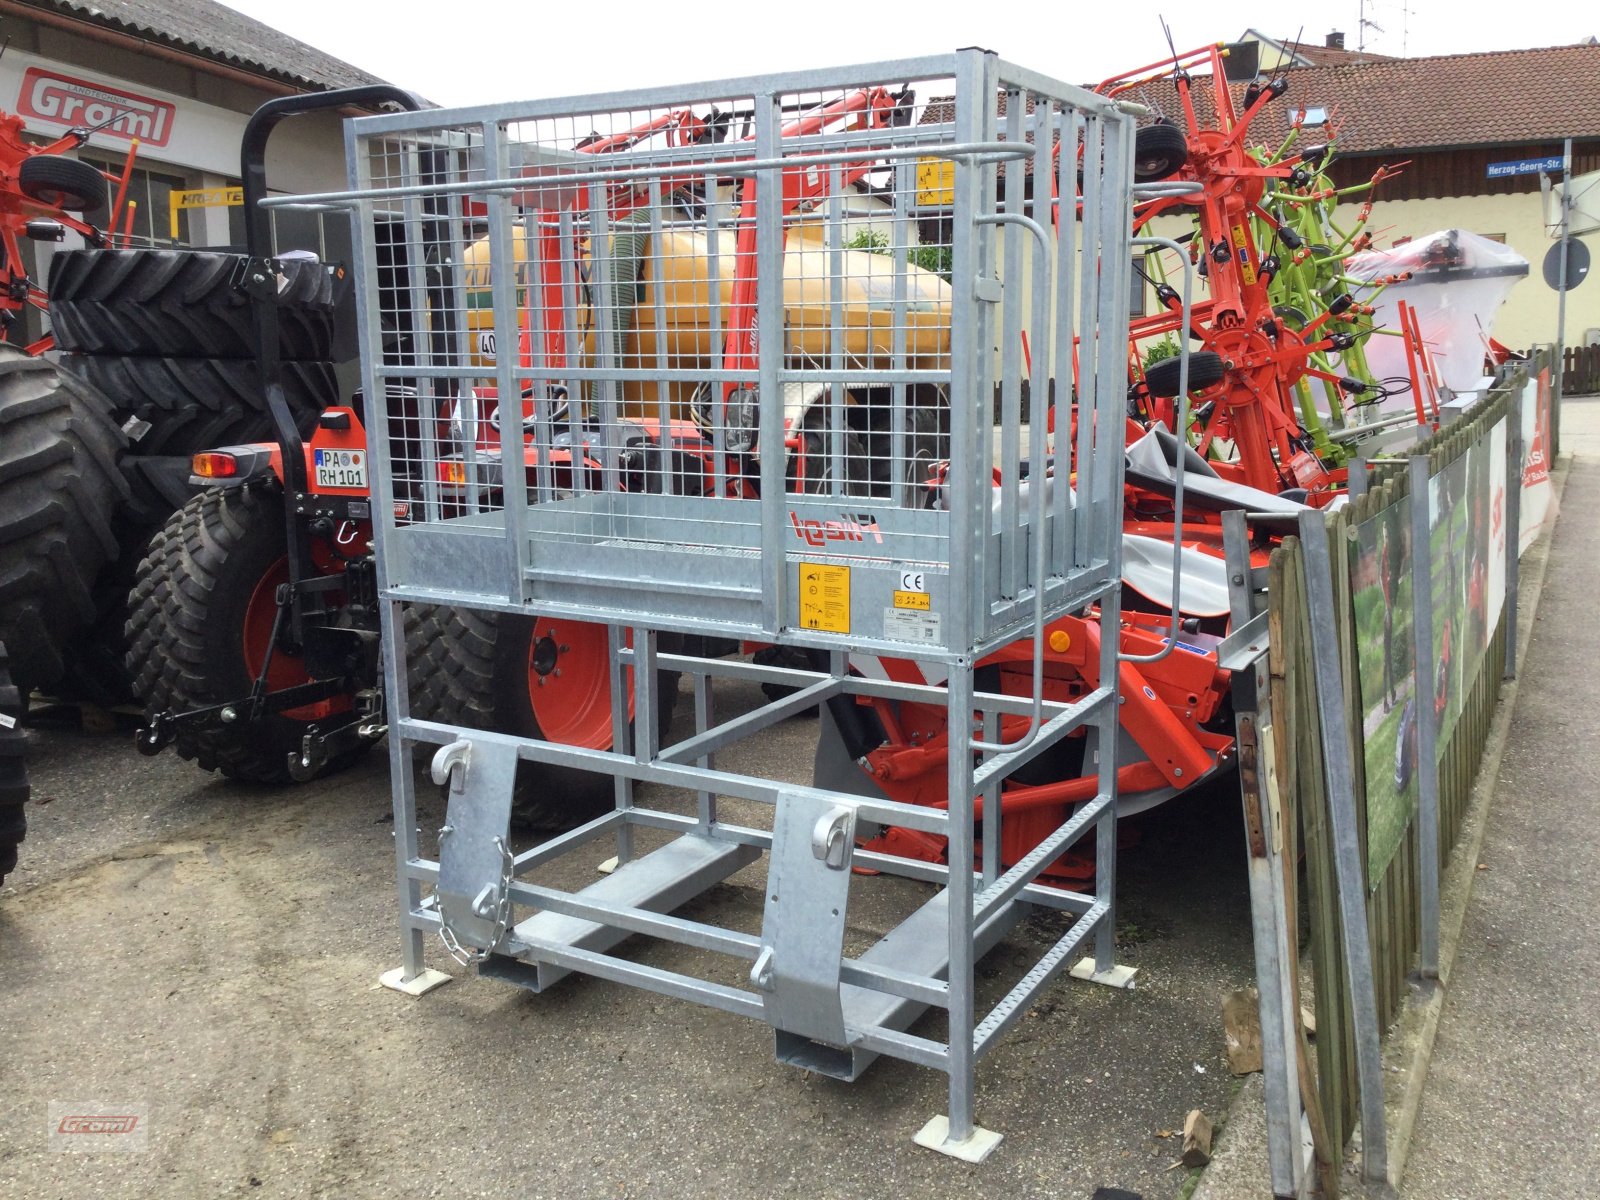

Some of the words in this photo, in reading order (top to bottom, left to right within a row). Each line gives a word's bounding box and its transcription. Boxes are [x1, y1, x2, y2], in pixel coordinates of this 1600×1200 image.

[67, 84, 127, 105] LANDTECHNIK
[31, 77, 167, 141] Graml
[324, 452, 340, 467] PA
[320, 469, 337, 485] RH
[339, 470, 363, 486] 101
[903, 574, 922, 590] CE
